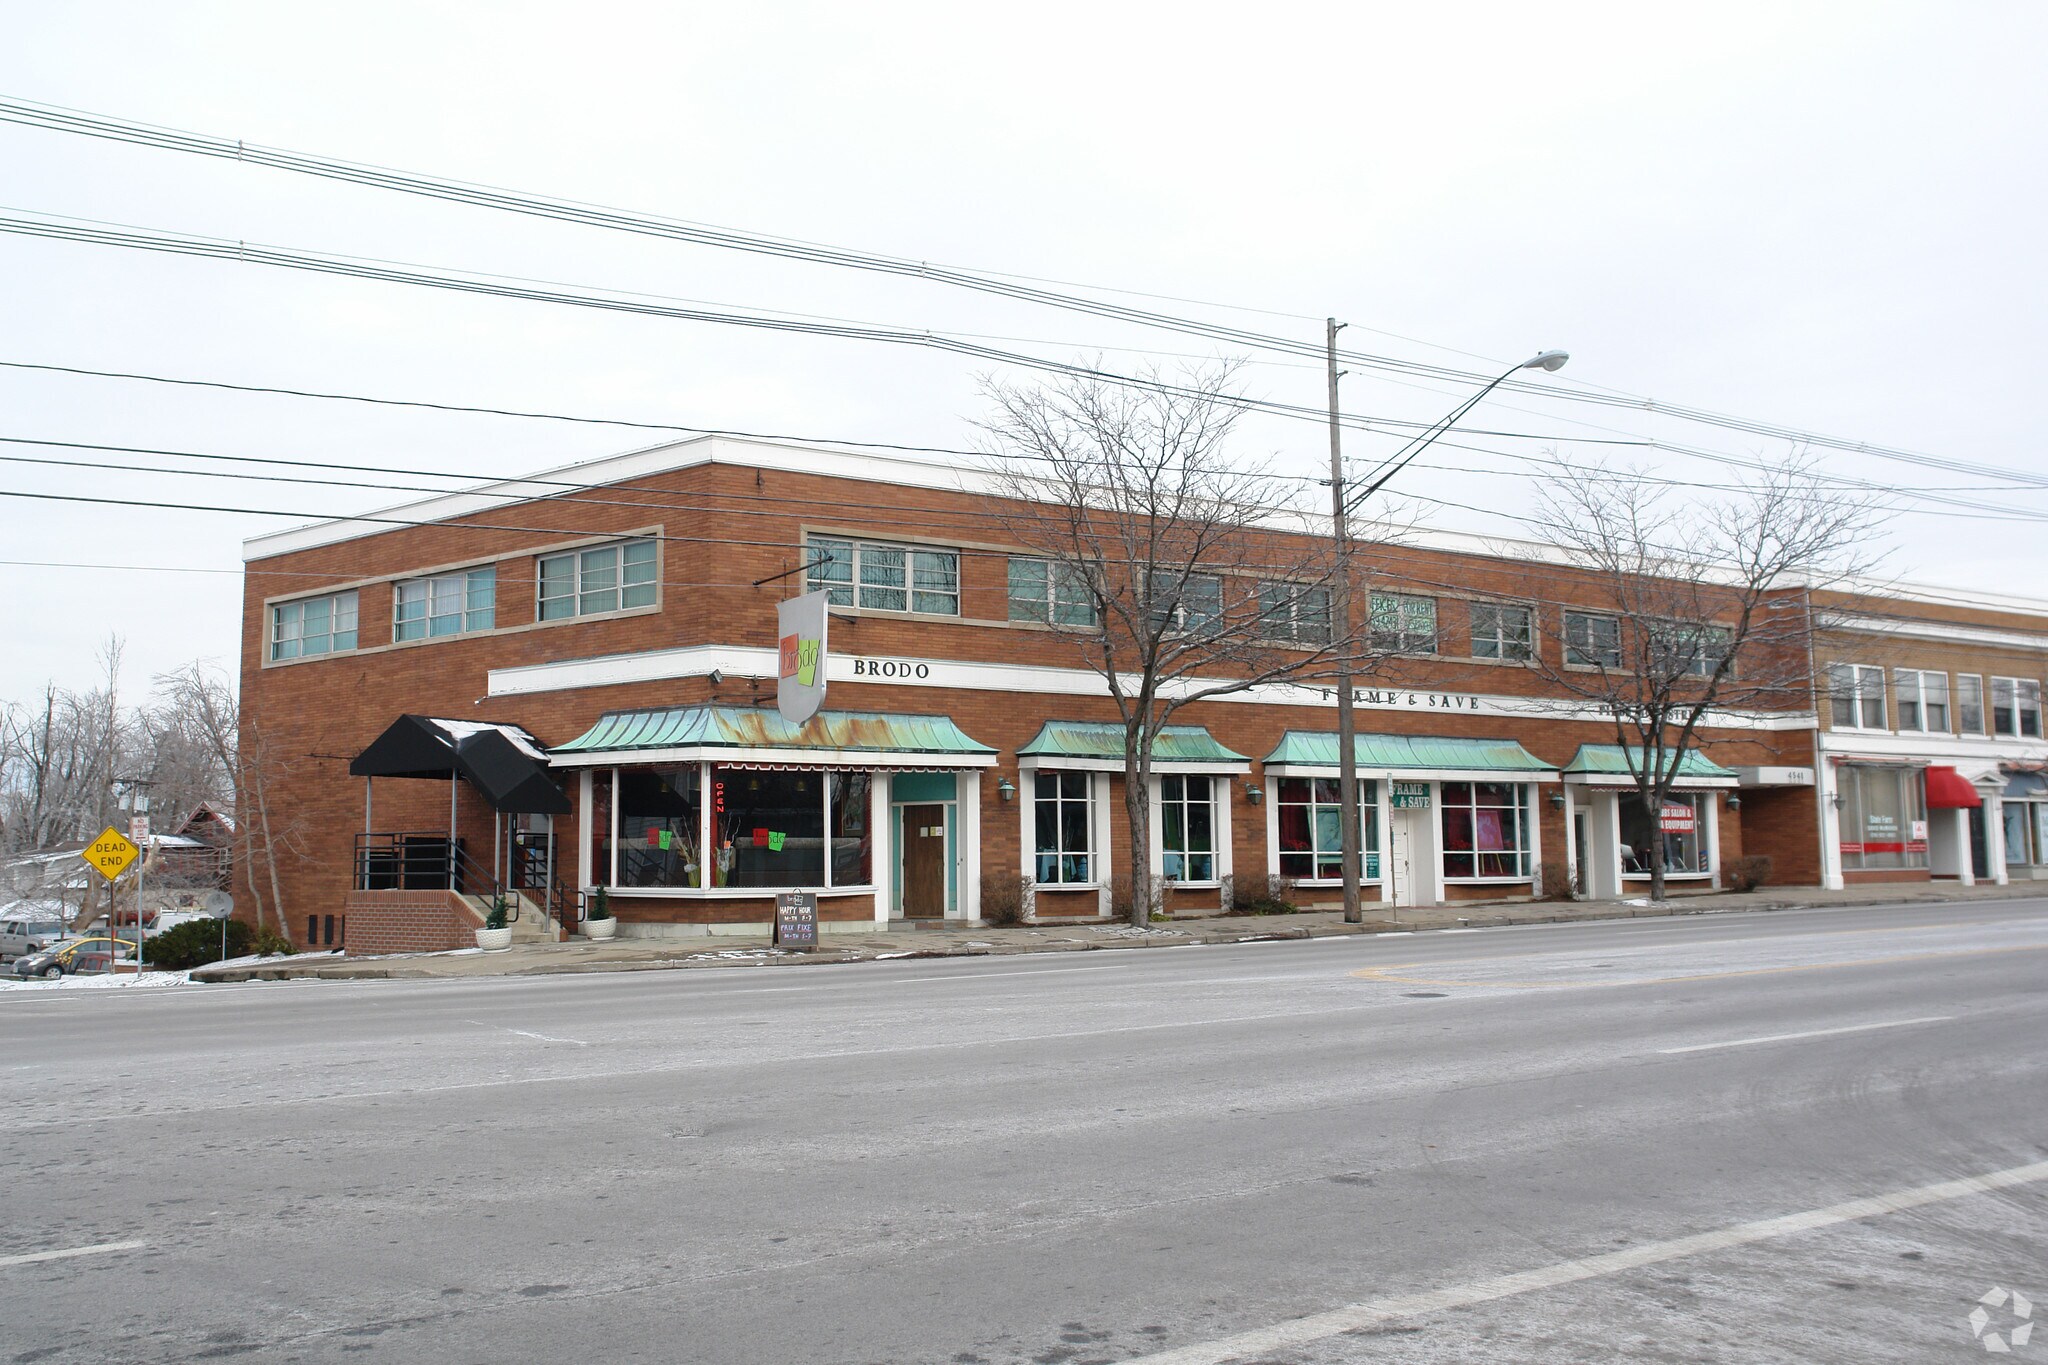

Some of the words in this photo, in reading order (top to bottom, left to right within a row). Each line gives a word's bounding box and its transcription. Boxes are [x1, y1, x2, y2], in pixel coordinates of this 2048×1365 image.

[783, 640, 819, 671] brodo
[854, 660, 929, 678] BRODO
[1322, 688, 1396, 705] FAME
[1408, 694, 1418, 706] &
[1429, 695, 1479, 710] SAVE
[1392, 783, 1423, 795] FRAME
[1400, 796, 1407, 808] &
[1408, 796, 1429, 808] SAVE
[1671, 808, 1686, 817] SALON
[96, 842, 126, 852] DEAD
[101, 856, 123, 866] END
[780, 906, 797, 914] HAPPY
